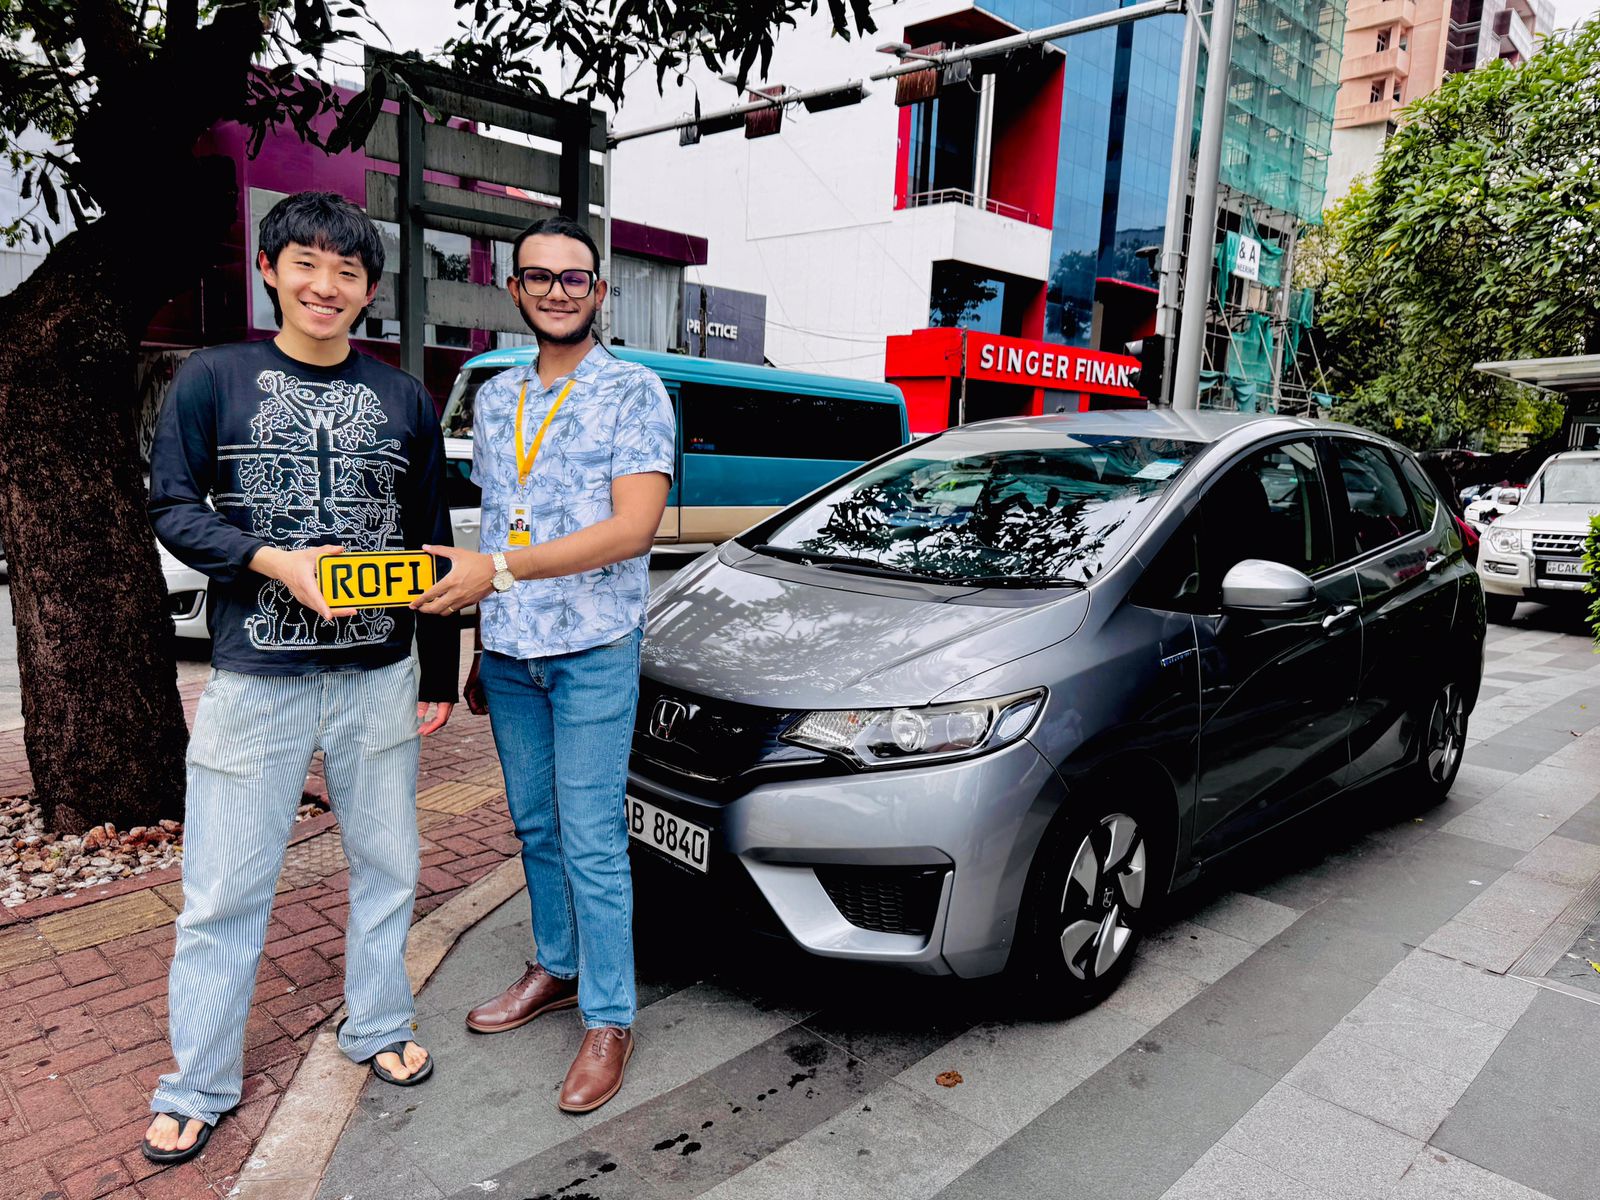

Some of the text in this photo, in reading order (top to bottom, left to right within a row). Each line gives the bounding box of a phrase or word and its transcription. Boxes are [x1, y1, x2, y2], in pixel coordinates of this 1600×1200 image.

[1249, 245, 1256, 264] A
[686, 318, 738, 340] PRCTICE
[980, 343, 1069, 380] SINGER
[305, 409, 336, 430] W
[1557, 563, 1578, 573] CAK
[331, 561, 425, 600] ROFI
[653, 812, 705, 865] 8840
